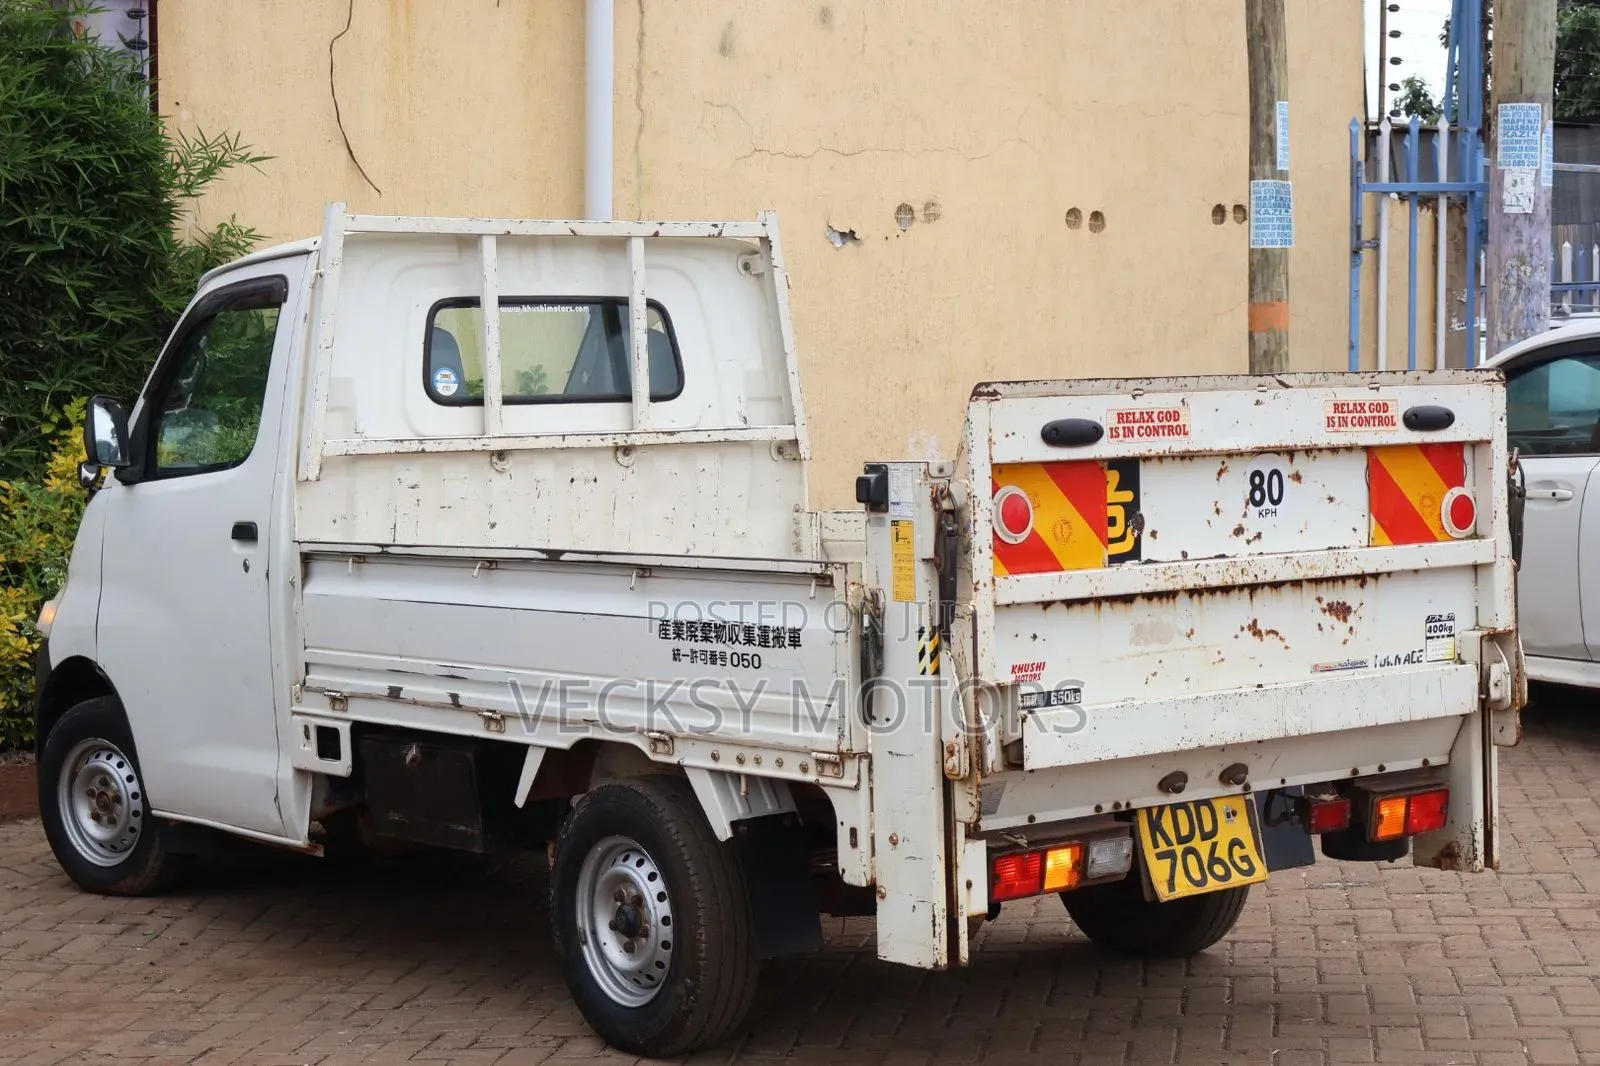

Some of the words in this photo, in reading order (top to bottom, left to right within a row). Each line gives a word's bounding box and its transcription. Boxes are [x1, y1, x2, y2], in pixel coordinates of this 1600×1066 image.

[500, 304, 590, 313] www.khushimotors.com
[1333, 402, 1366, 414] RELAX
[1368, 401, 1389, 413] GOD
[1116, 411, 1156, 425] RELAX
[1157, 410, 1180, 422] GOD
[1326, 416, 1337, 428] IS
[1338, 416, 1350, 428] IN
[1350, 414, 1397, 427] CONTROL
[1109, 426, 1121, 439] IS
[1122, 426, 1135, 439] IN
[1136, 424, 1189, 438] CONTROL
[1249, 468, 1284, 508] 80
[1258, 508, 1277, 519] KPH
[658, 619, 802, 650] 産業廃棄物収集運搬車
[1427, 623, 1453, 635] 400kg
[1011, 661, 1046, 675] KHUSHI
[1014, 673, 1041, 683] MOTORS
[1050, 690, 1081, 706] 650kg
[1145, 799, 1219, 849] KDD
[1155, 837, 1256, 893] 706G
